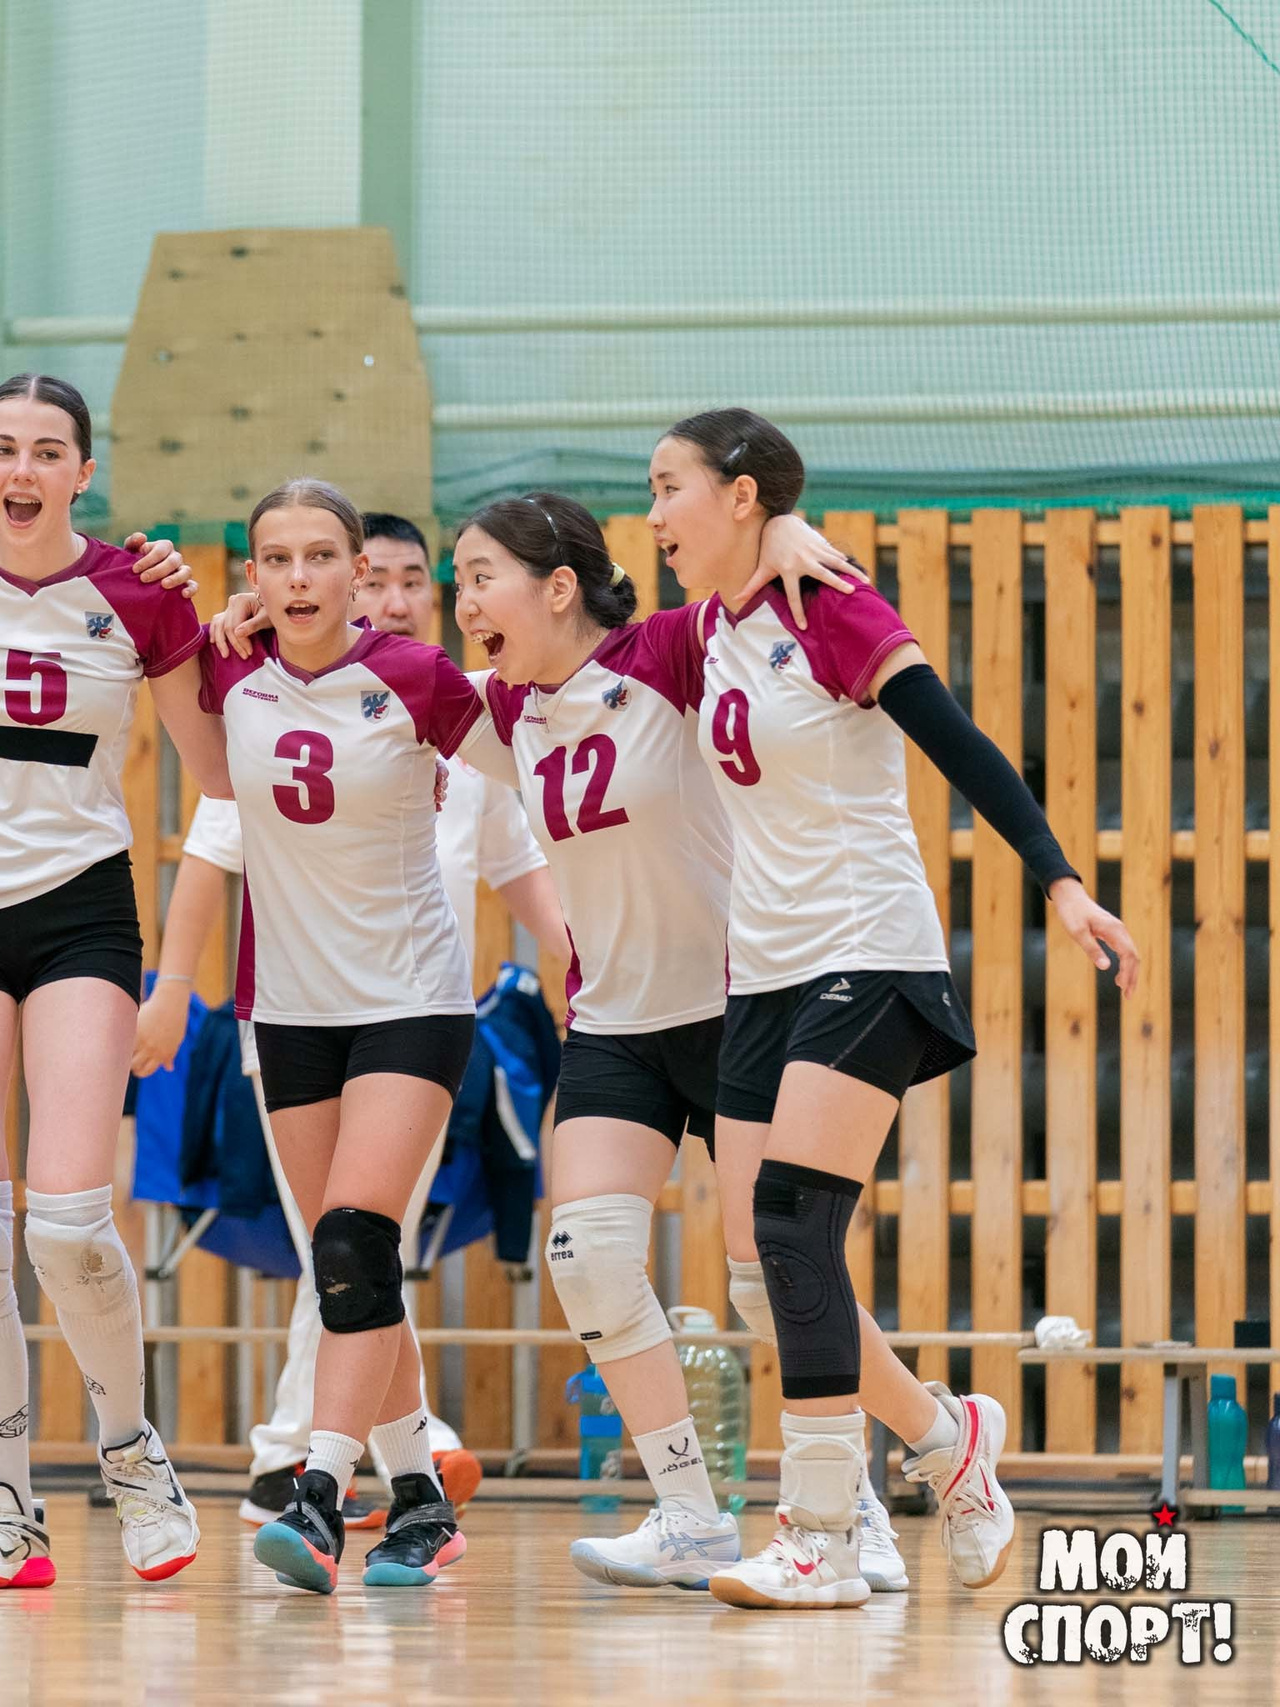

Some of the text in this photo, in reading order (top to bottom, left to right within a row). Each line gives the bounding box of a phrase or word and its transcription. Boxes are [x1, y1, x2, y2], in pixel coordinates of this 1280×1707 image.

[4, 649, 68, 726] 5
[272, 730, 335, 825] 3
[711, 688, 761, 787] 9
[533, 733, 630, 842] 12
